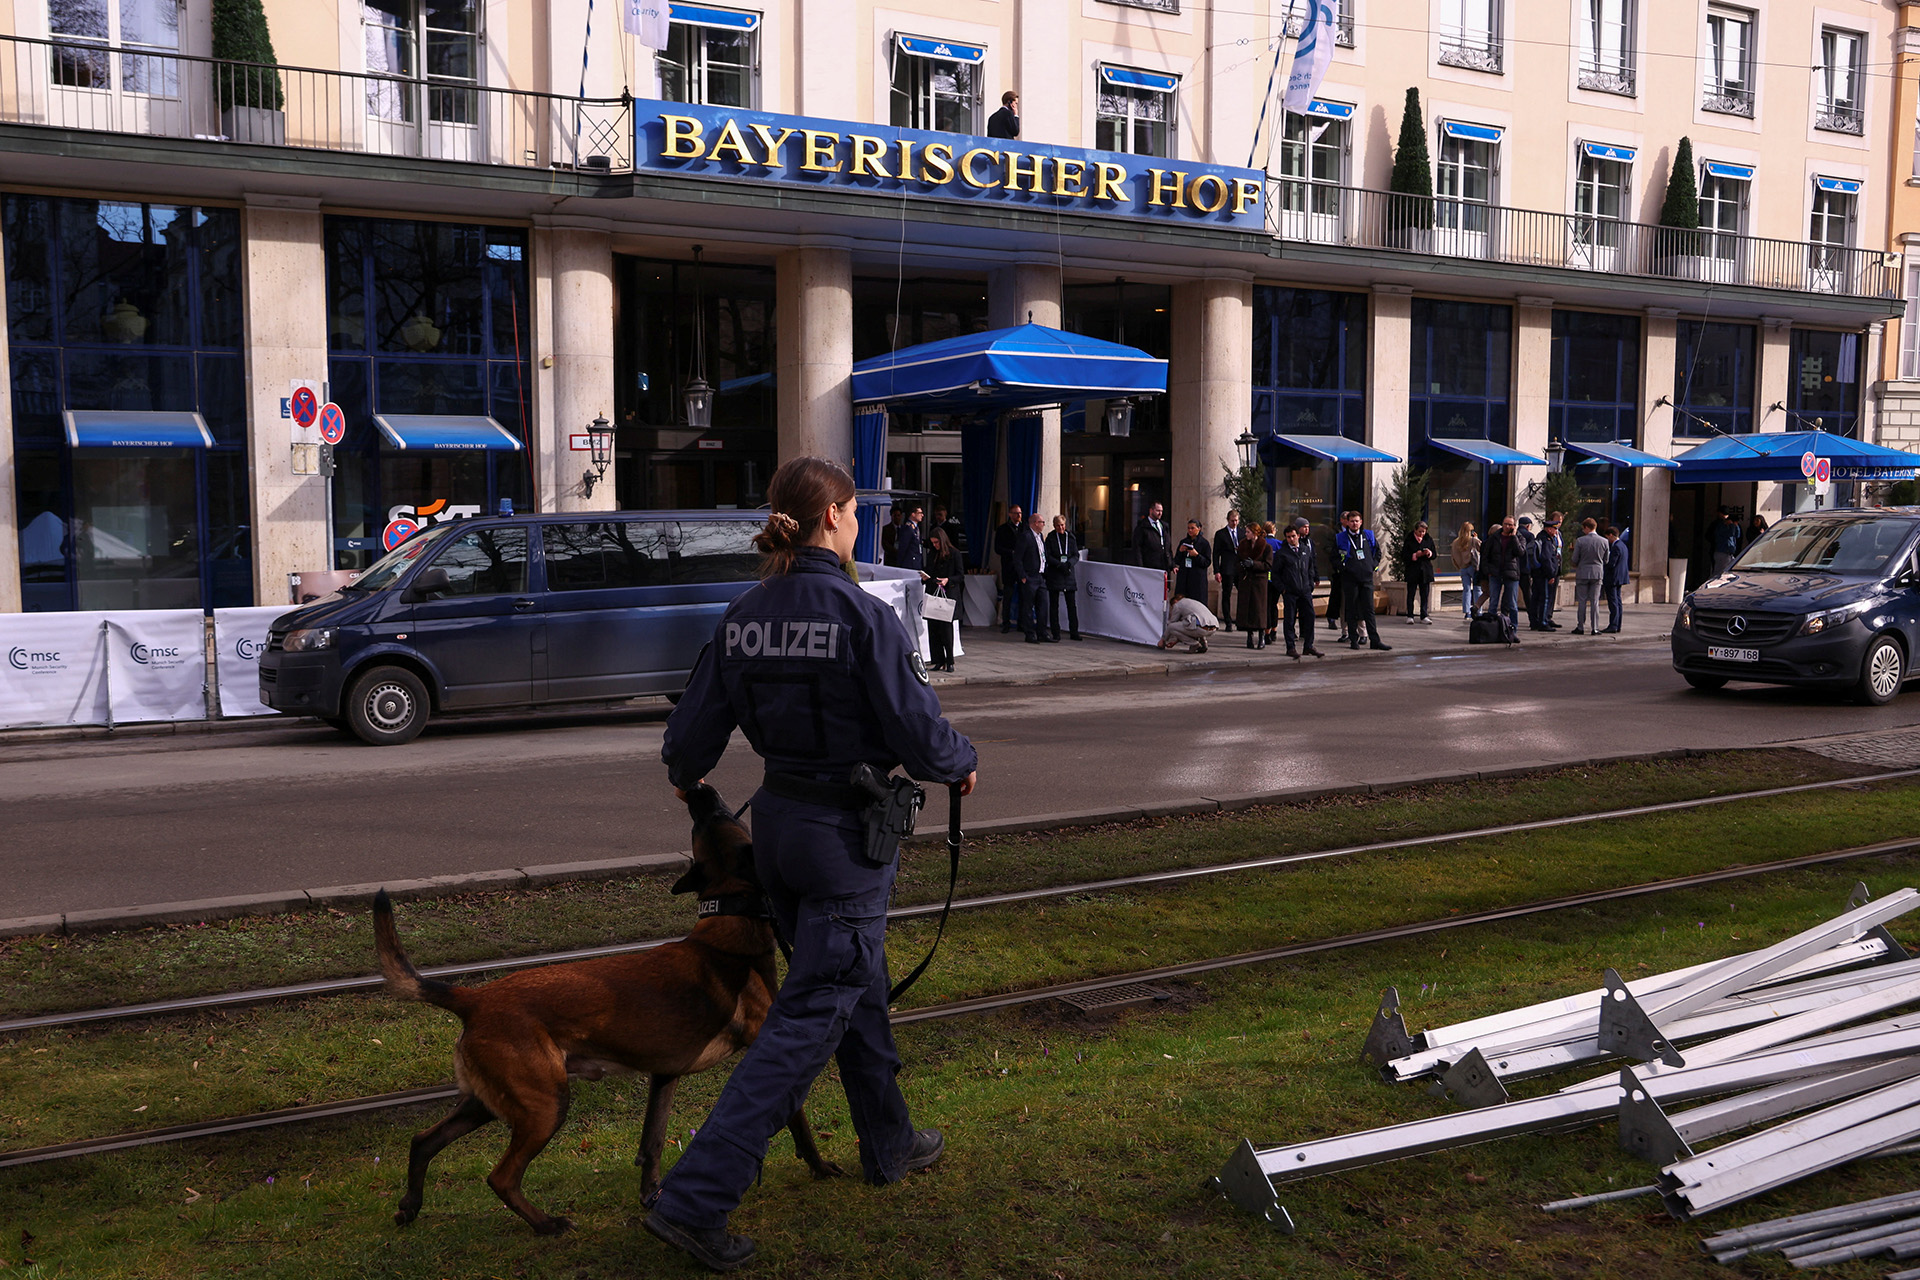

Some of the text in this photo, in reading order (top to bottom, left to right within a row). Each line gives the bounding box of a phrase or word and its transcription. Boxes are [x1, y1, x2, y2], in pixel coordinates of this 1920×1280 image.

[659, 113, 1262, 214] BAYERISCHER HOF
[1830, 467, 1870, 477] HOTEL
[1093, 586, 1106, 594] msc
[1131, 591, 1145, 600] msc
[726, 621, 839, 659] POLIZEI
[31, 652, 60, 661] msc
[151, 647, 178, 657] msc
[1724, 648, 1739, 659] 897
[1743, 650, 1758, 660] 168
